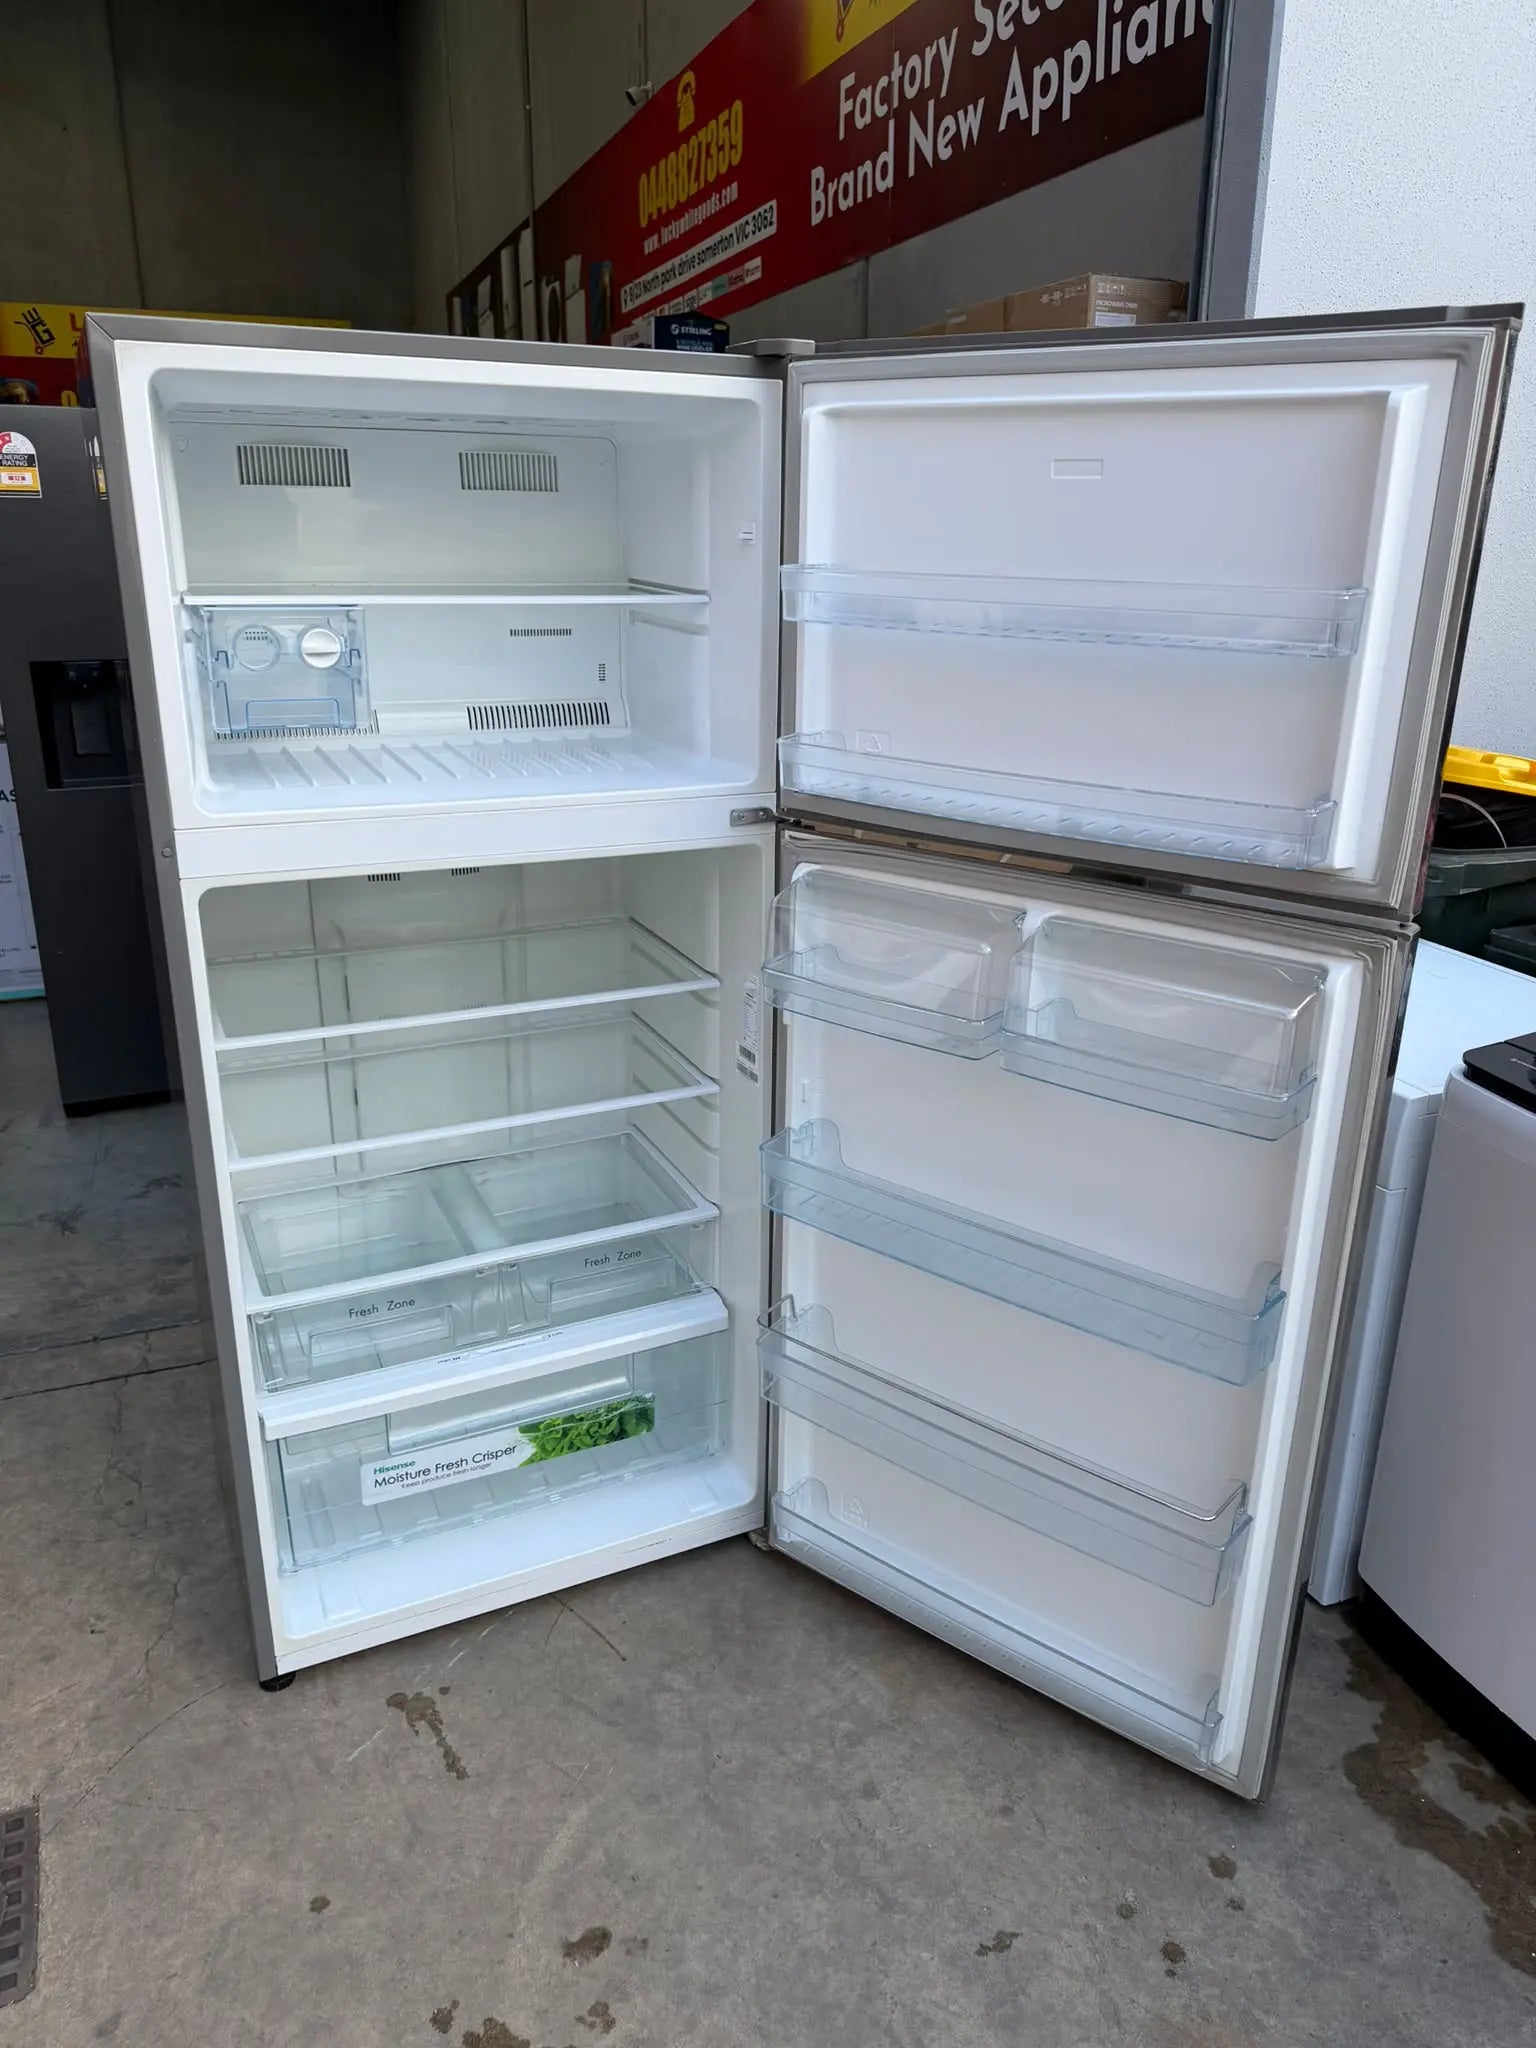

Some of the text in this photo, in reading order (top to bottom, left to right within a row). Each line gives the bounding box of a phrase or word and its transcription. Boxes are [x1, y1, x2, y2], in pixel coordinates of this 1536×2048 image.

[838, 26, 958, 141] Factory
[639, 99, 743, 228] 0448827359
[810, 118, 895, 227] Brand
[908, 96, 986, 179] New
[661, 262, 677, 288] park
[678, 250, 696, 277] drive
[697, 232, 735, 266] somerton
[734, 222, 751, 245] VIC
[751, 204, 774, 236] 3062
[680, 326, 712, 336] STIRLING
[584, 1249, 642, 1268] Fresh Zone
[349, 1297, 416, 1319] Fresh Zone
[373, 1460, 416, 1475] Hisense
[374, 1445, 517, 1488] Moisture Fresh Crisper
[401, 1462, 492, 1489] Keep produce fresh longer
